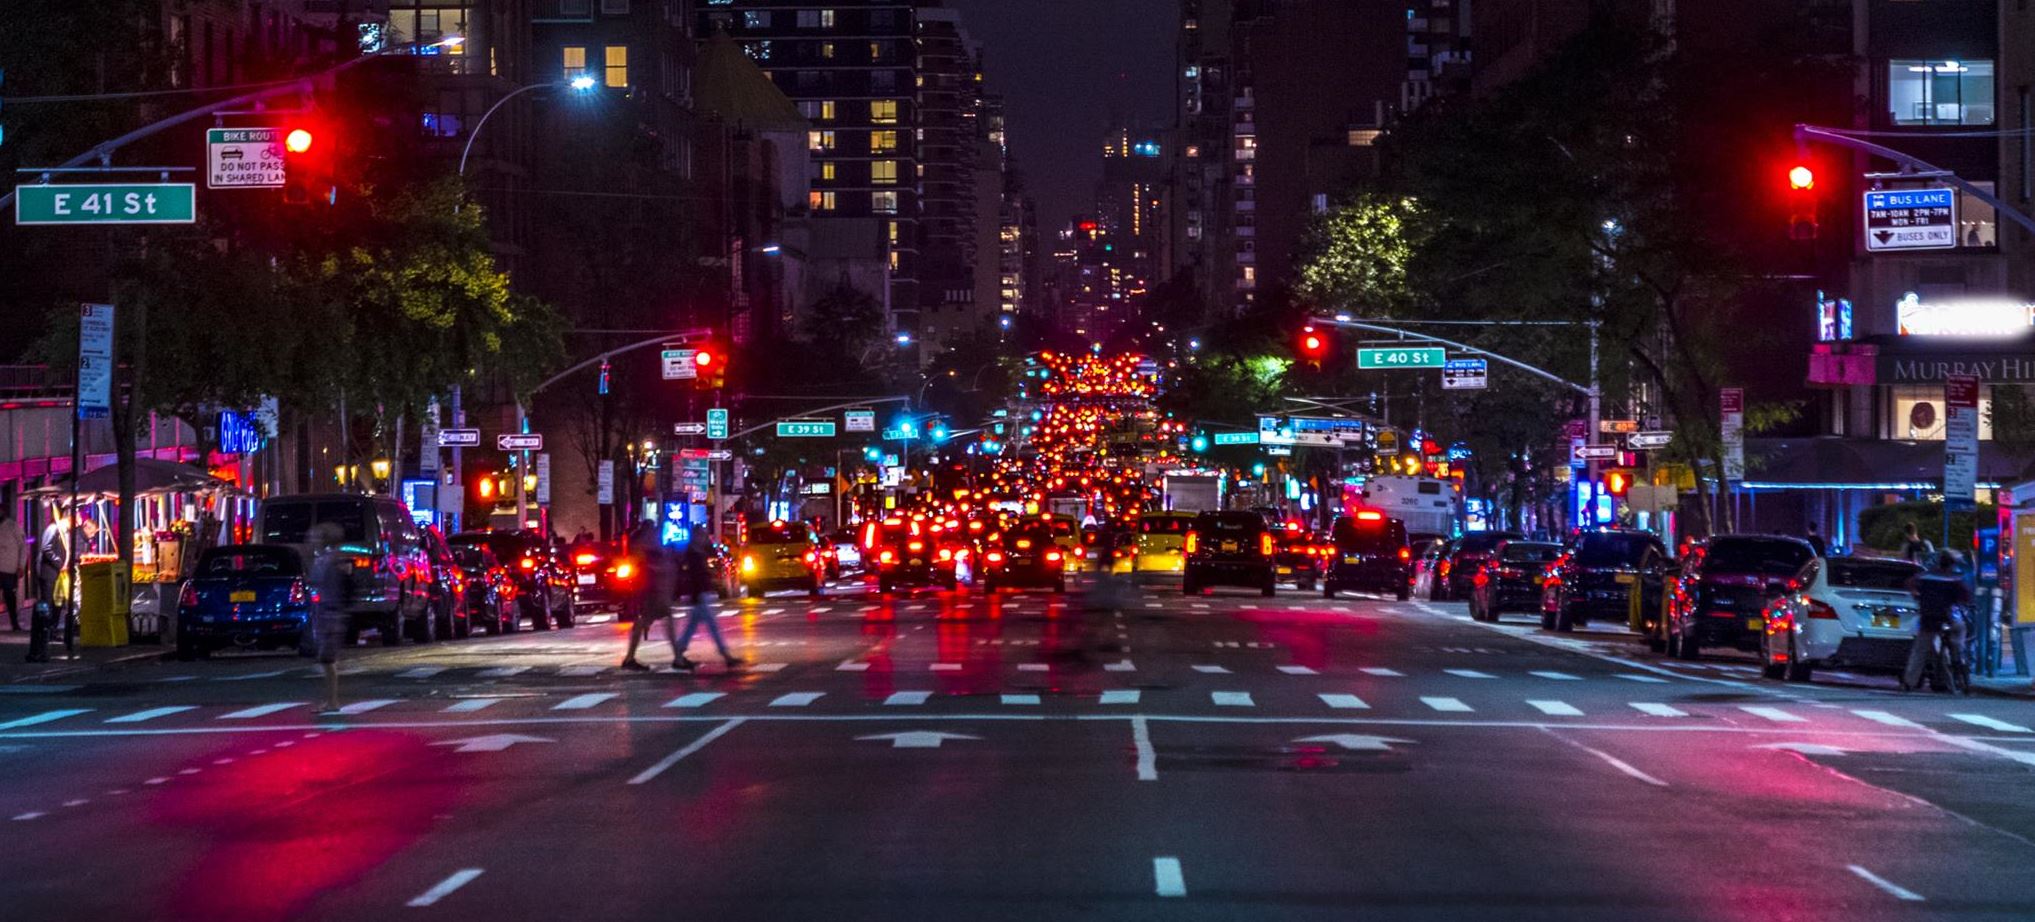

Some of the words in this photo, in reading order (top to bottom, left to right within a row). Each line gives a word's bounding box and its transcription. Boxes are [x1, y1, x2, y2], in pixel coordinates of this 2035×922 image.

[223, 132, 247, 141] BIKE
[220, 163, 234, 171] DO
[238, 162, 256, 170] NOT
[214, 174, 223, 183] IN
[226, 174, 264, 182] SHARED
[54, 194, 71, 214] E
[81, 193, 112, 214] 41
[124, 192, 156, 214] St
[1890, 196, 1912, 204] BUS
[1916, 194, 1945, 204] LANE
[1914, 208, 1949, 216] 2PM-7PM
[1897, 232, 1924, 241] BUSES
[1928, 232, 1948, 240] ONLY
[1374, 354, 1383, 364] E
[1388, 353, 1408, 364] 40
[1412, 352, 1429, 364] St
[1896, 361, 1996, 380] MURRAY
